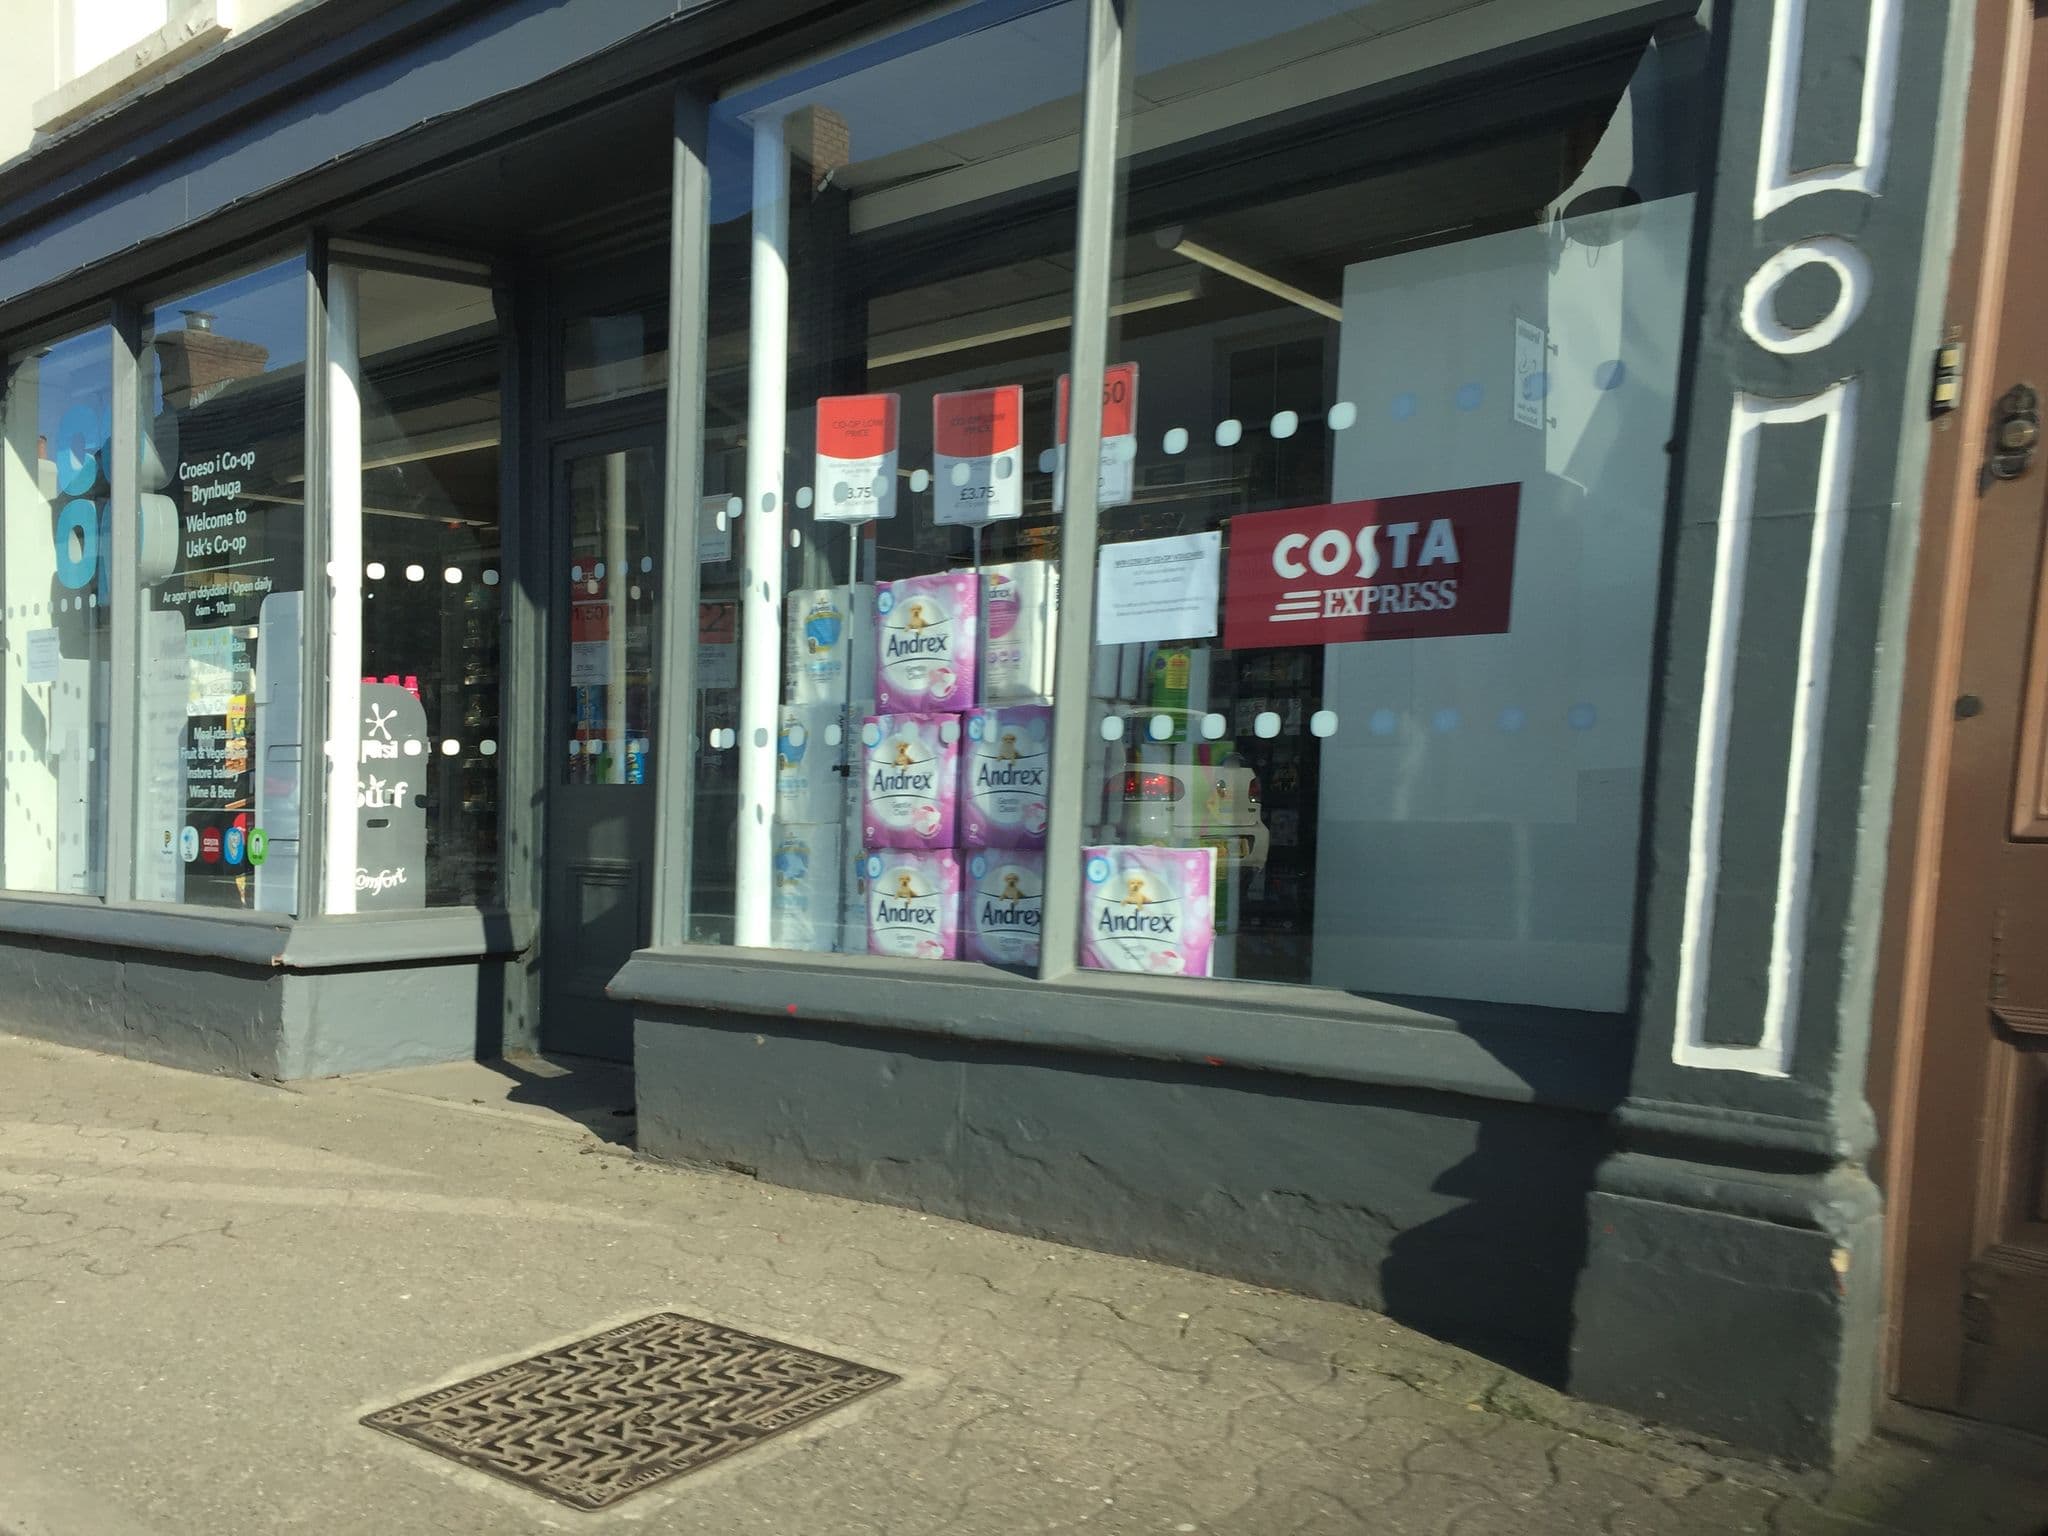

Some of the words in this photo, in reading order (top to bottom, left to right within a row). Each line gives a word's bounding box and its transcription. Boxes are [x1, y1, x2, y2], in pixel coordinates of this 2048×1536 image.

[179, 461, 215, 481] Croeso
[216, 454, 220, 472] i
[222, 451, 255, 471] Co-op
[191, 480, 241, 506] Brynbuga
[960, 486, 996, 501] £3.75
[186, 512, 234, 533] Welcome
[235, 508, 247, 524] to
[186, 539, 212, 558] Usk's
[214, 535, 246, 555] Co-op
[1272, 518, 1460, 579] COSTA
[233, 581, 254, 596] Open
[254, 576, 272, 592] daily
[1321, 579, 1457, 618] EXPRESS
[195, 604, 211, 616] 6am
[216, 600, 236, 616] 10pm
[887, 632, 948, 658] Andrex
[872, 768, 933, 792] Andrex
[977, 762, 1045, 788] Andrex
[189, 785, 209, 798] Wine
[210, 784, 216, 798] &
[217, 784, 237, 798] Beer
[876, 900, 936, 924] Andrex
[1098, 907, 1174, 933] Andrex
